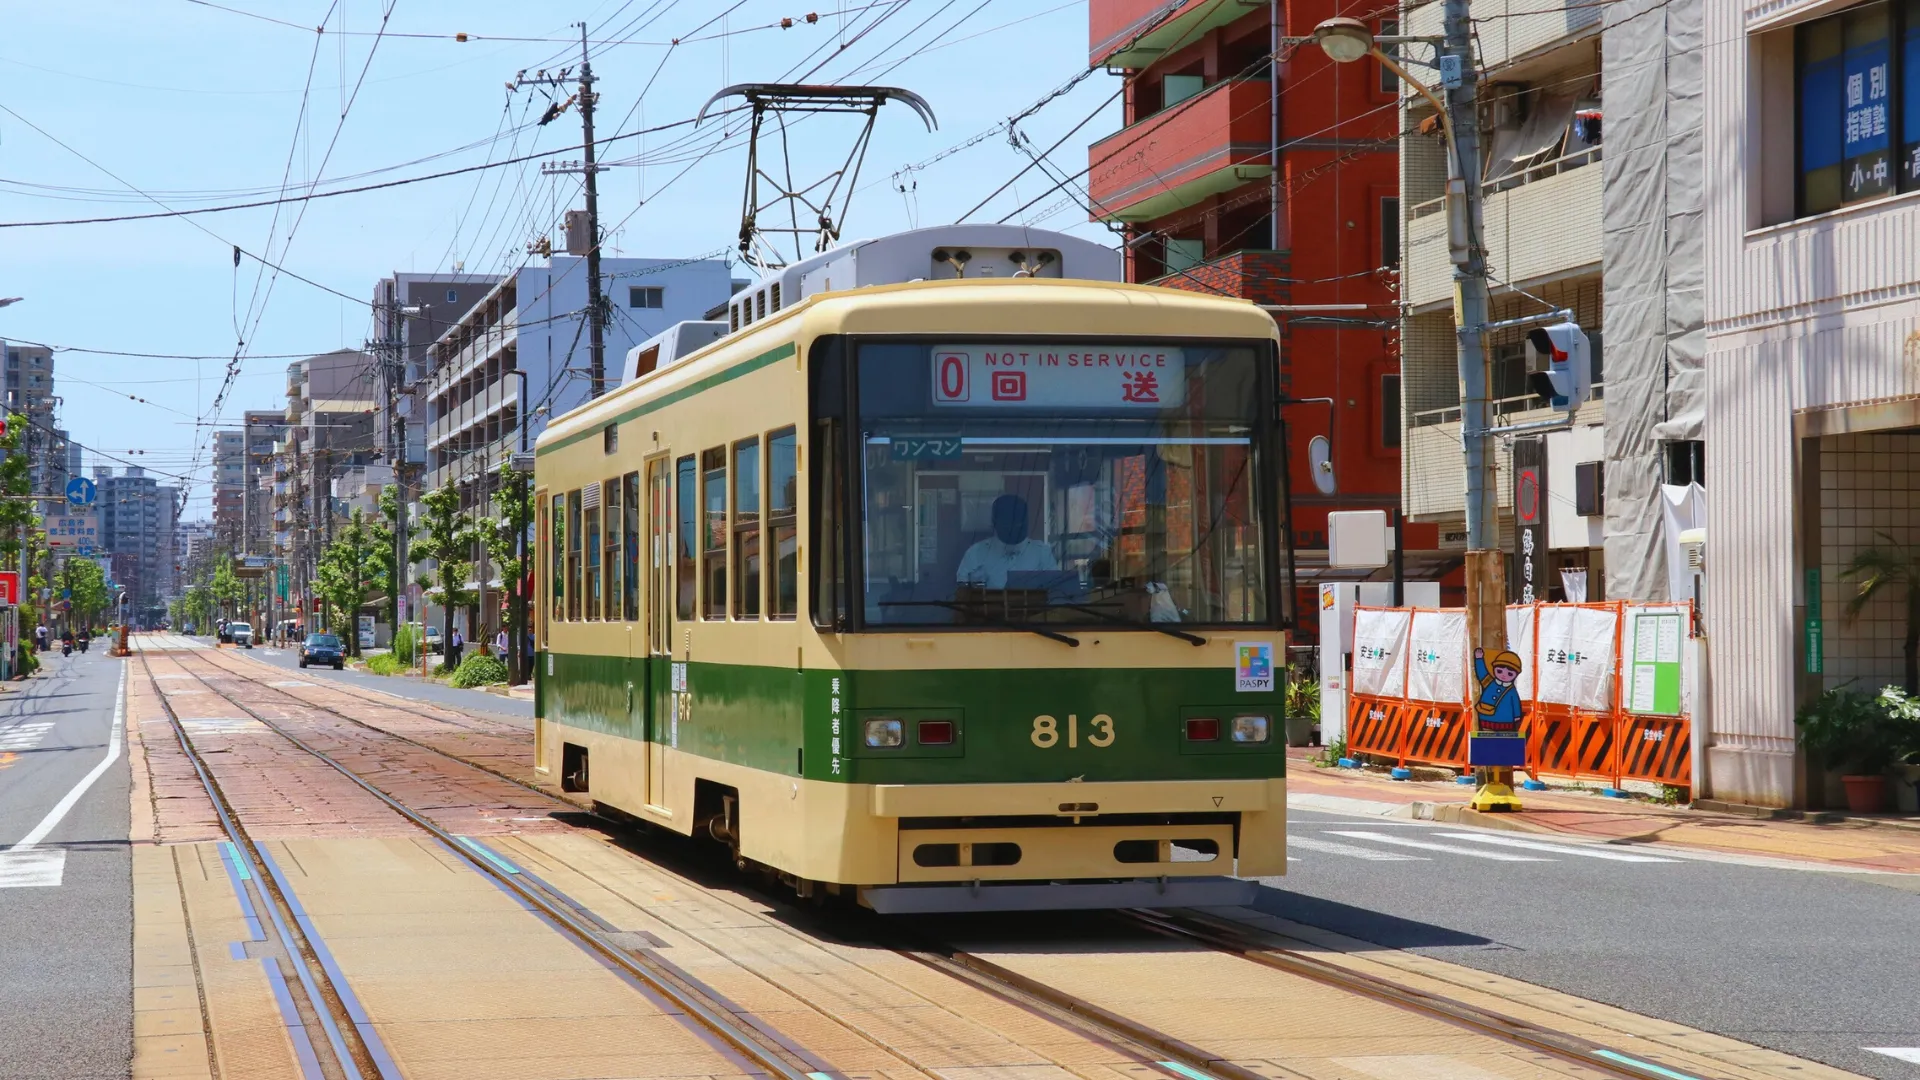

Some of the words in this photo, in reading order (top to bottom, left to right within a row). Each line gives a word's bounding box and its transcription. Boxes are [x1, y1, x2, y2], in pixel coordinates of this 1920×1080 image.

[1847, 63, 1886, 108] 個別
[1847, 104, 1886, 143] 指導塾
[986, 352, 1030, 367] NOT
[1039, 353, 1059, 367] IN
[1068, 352, 1167, 367] SERVICE
[893, 438, 961, 457] ワンマン
[1240, 680, 1269, 688] PASPY
[831, 678, 840, 775] 乗降者優先
[1030, 714, 1115, 748] 813
